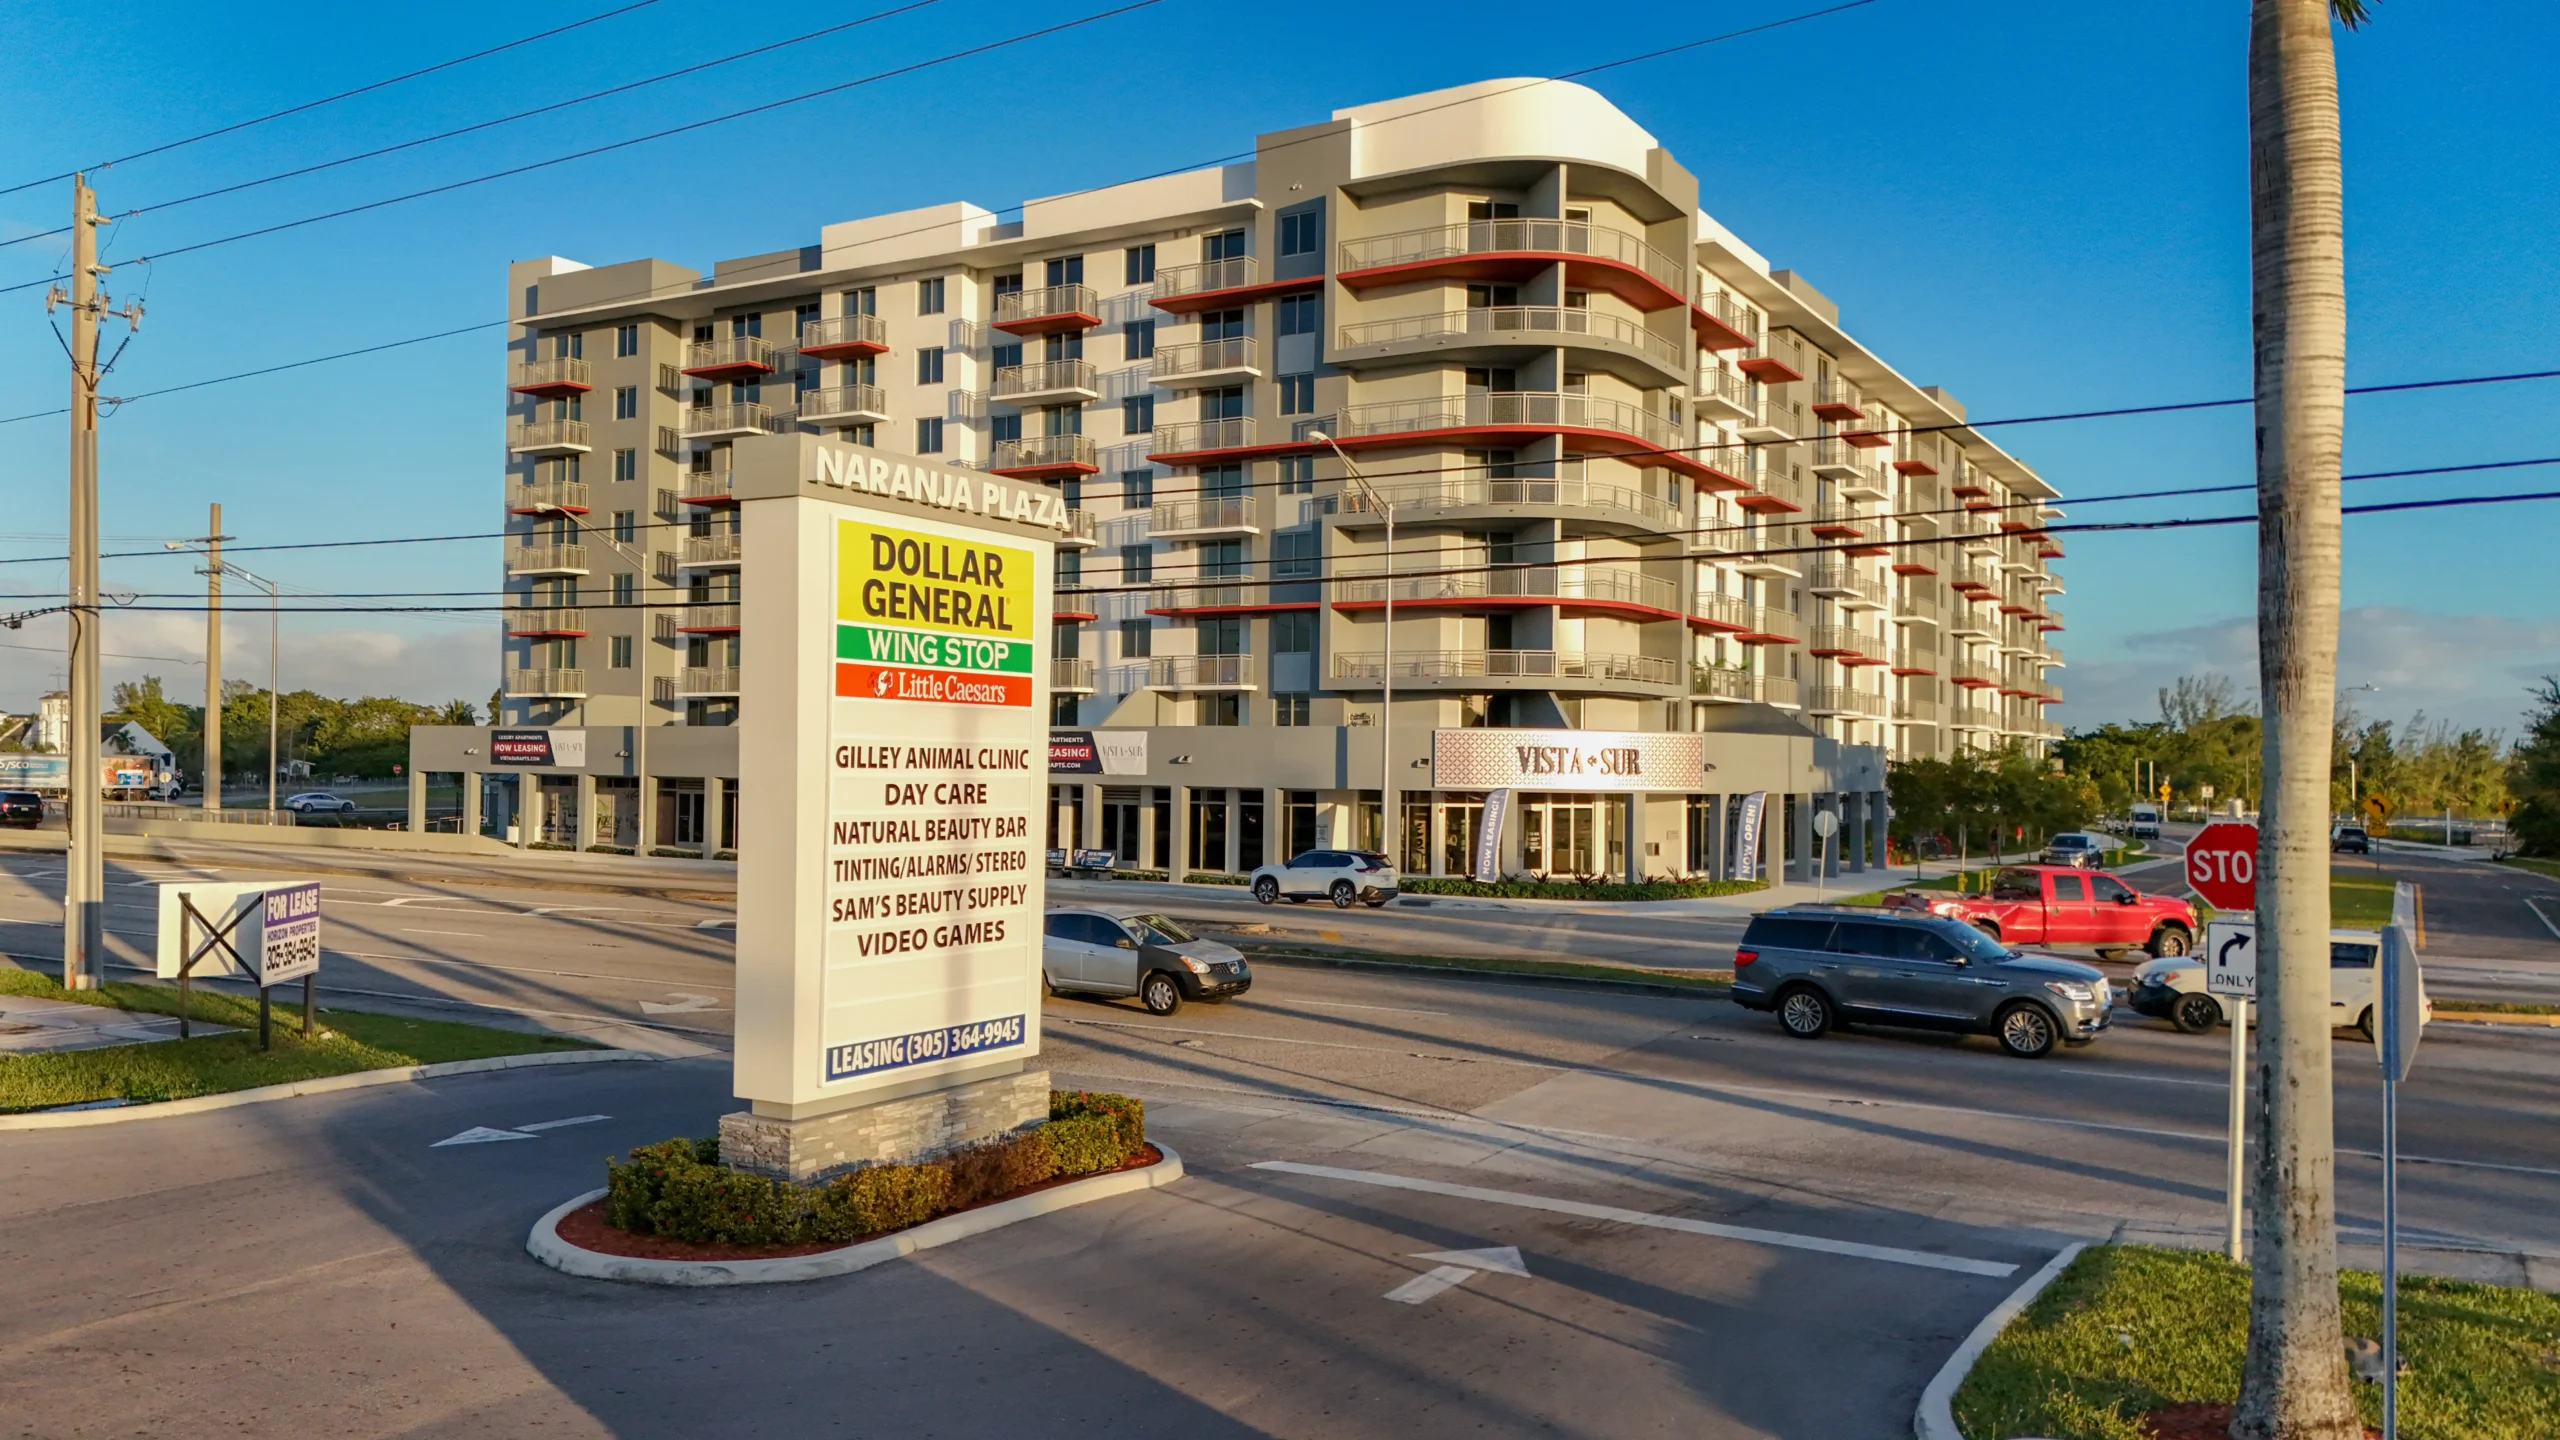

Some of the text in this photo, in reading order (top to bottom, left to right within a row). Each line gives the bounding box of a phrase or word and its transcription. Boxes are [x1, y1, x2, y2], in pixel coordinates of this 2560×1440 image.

[816, 446, 1071, 532] NARANJA PLAZA
[870, 533, 1004, 588] DOLLAR
[862, 579, 1013, 631] GENERAL
[867, 629, 1009, 670] WING STOP
[897, 671, 1006, 703] Little Caesars
[513, 744, 546, 752] LEASING!
[835, 745, 1029, 770] GILLEY ANIMAL CLINIC
[1048, 748, 1089, 757] EASING!
[1516, 746, 1642, 775] VISTA SUR
[885, 783, 987, 806] DAY CARE
[833, 816, 1027, 845] NATURAL BEAUTY BAR
[1485, 800, 1499, 846] LEASING!
[1744, 804, 1756, 841] OPEN!
[834, 850, 1026, 882] TINTING/ALARMS/ STEREO
[1483, 849, 1491, 875] NOW
[1742, 844, 1752, 874] NOW
[2193, 849, 2253, 884] STO
[267, 888, 318, 921] FOR LEASE
[832, 884, 1027, 922] SAM'S BEAUTY SUPPLY
[266, 921, 317, 943] HORIZON PROPERTIES
[857, 920, 1005, 957] VIDEO GAMES
[266, 935, 316, 971] 305-364-9945
[2215, 973, 2255, 988] ONLY
[831, 1017, 1020, 1075] LEASING (305) 364-9945
